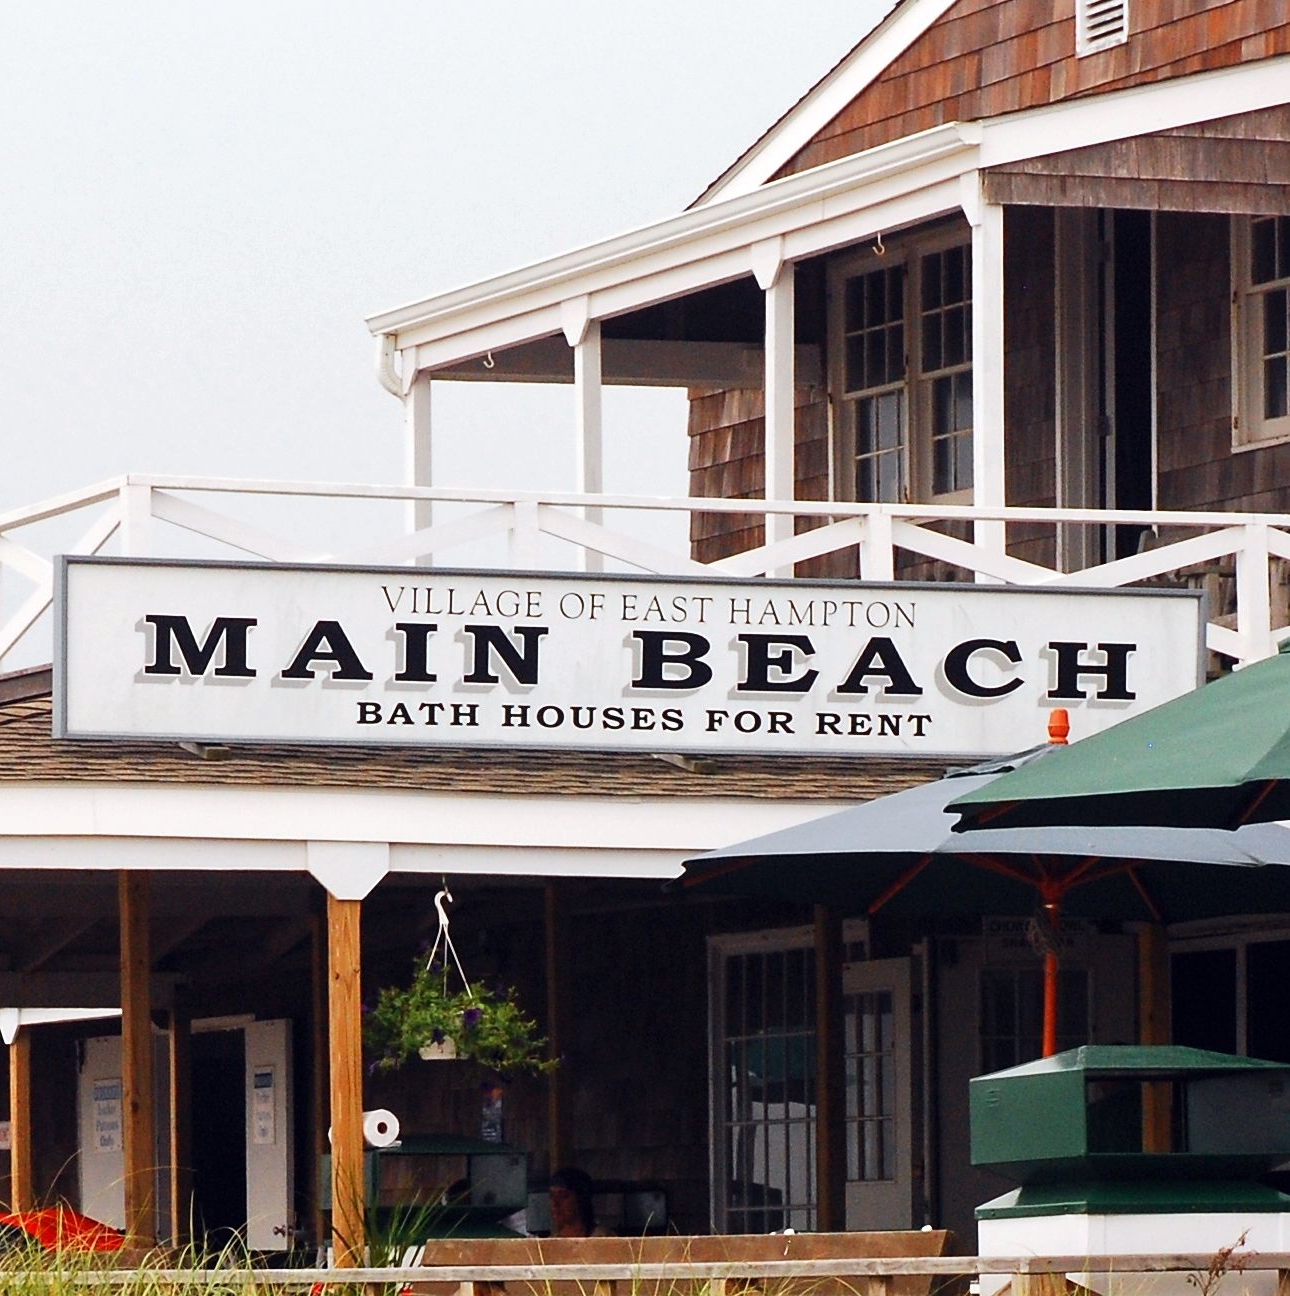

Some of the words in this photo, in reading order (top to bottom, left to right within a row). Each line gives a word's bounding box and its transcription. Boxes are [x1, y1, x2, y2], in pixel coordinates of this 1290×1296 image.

[381, 585, 543, 618] VILLAGE
[560, 592, 605, 621] OF
[620, 593, 713, 624] EAST
[727, 597, 917, 629] HAMPTON
[143, 613, 550, 686] MAIN
[629, 629, 1138, 701] BEACH
[356, 701, 480, 727] BATH
[501, 704, 685, 733] HOUSES
[705, 708, 795, 735] FOR
[815, 711, 933, 738] RENT
